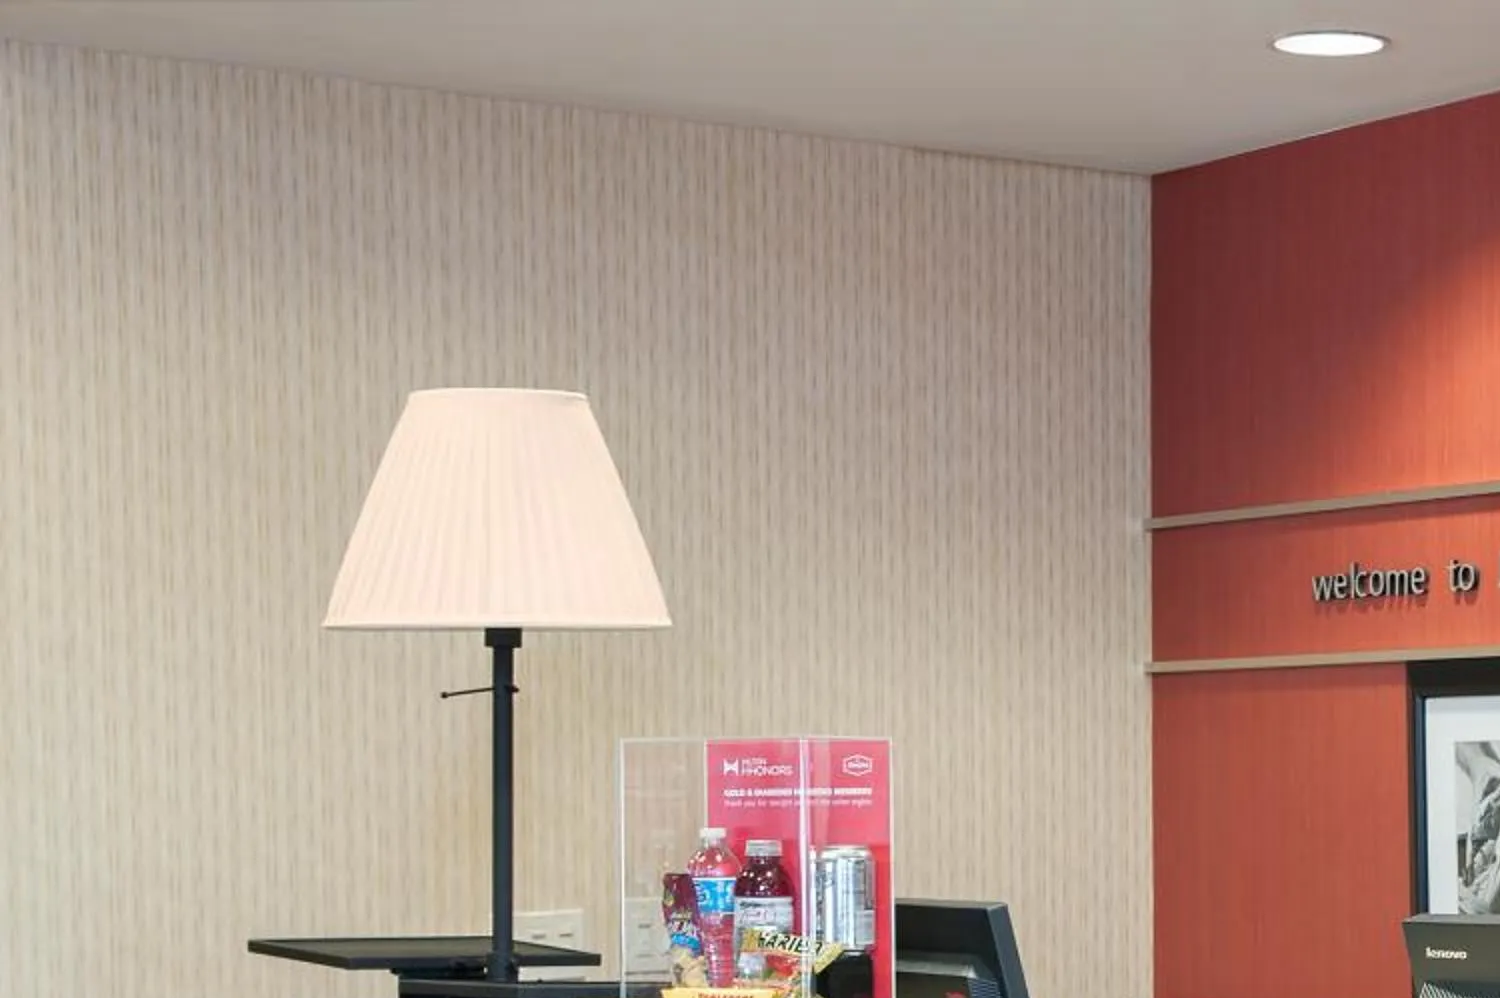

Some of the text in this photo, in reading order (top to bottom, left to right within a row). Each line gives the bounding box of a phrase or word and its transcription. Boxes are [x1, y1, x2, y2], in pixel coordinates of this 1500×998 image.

[1311, 562, 1427, 601] welcome
[1448, 559, 1478, 593] to
[1425, 946, 1467, 959] lenovo
